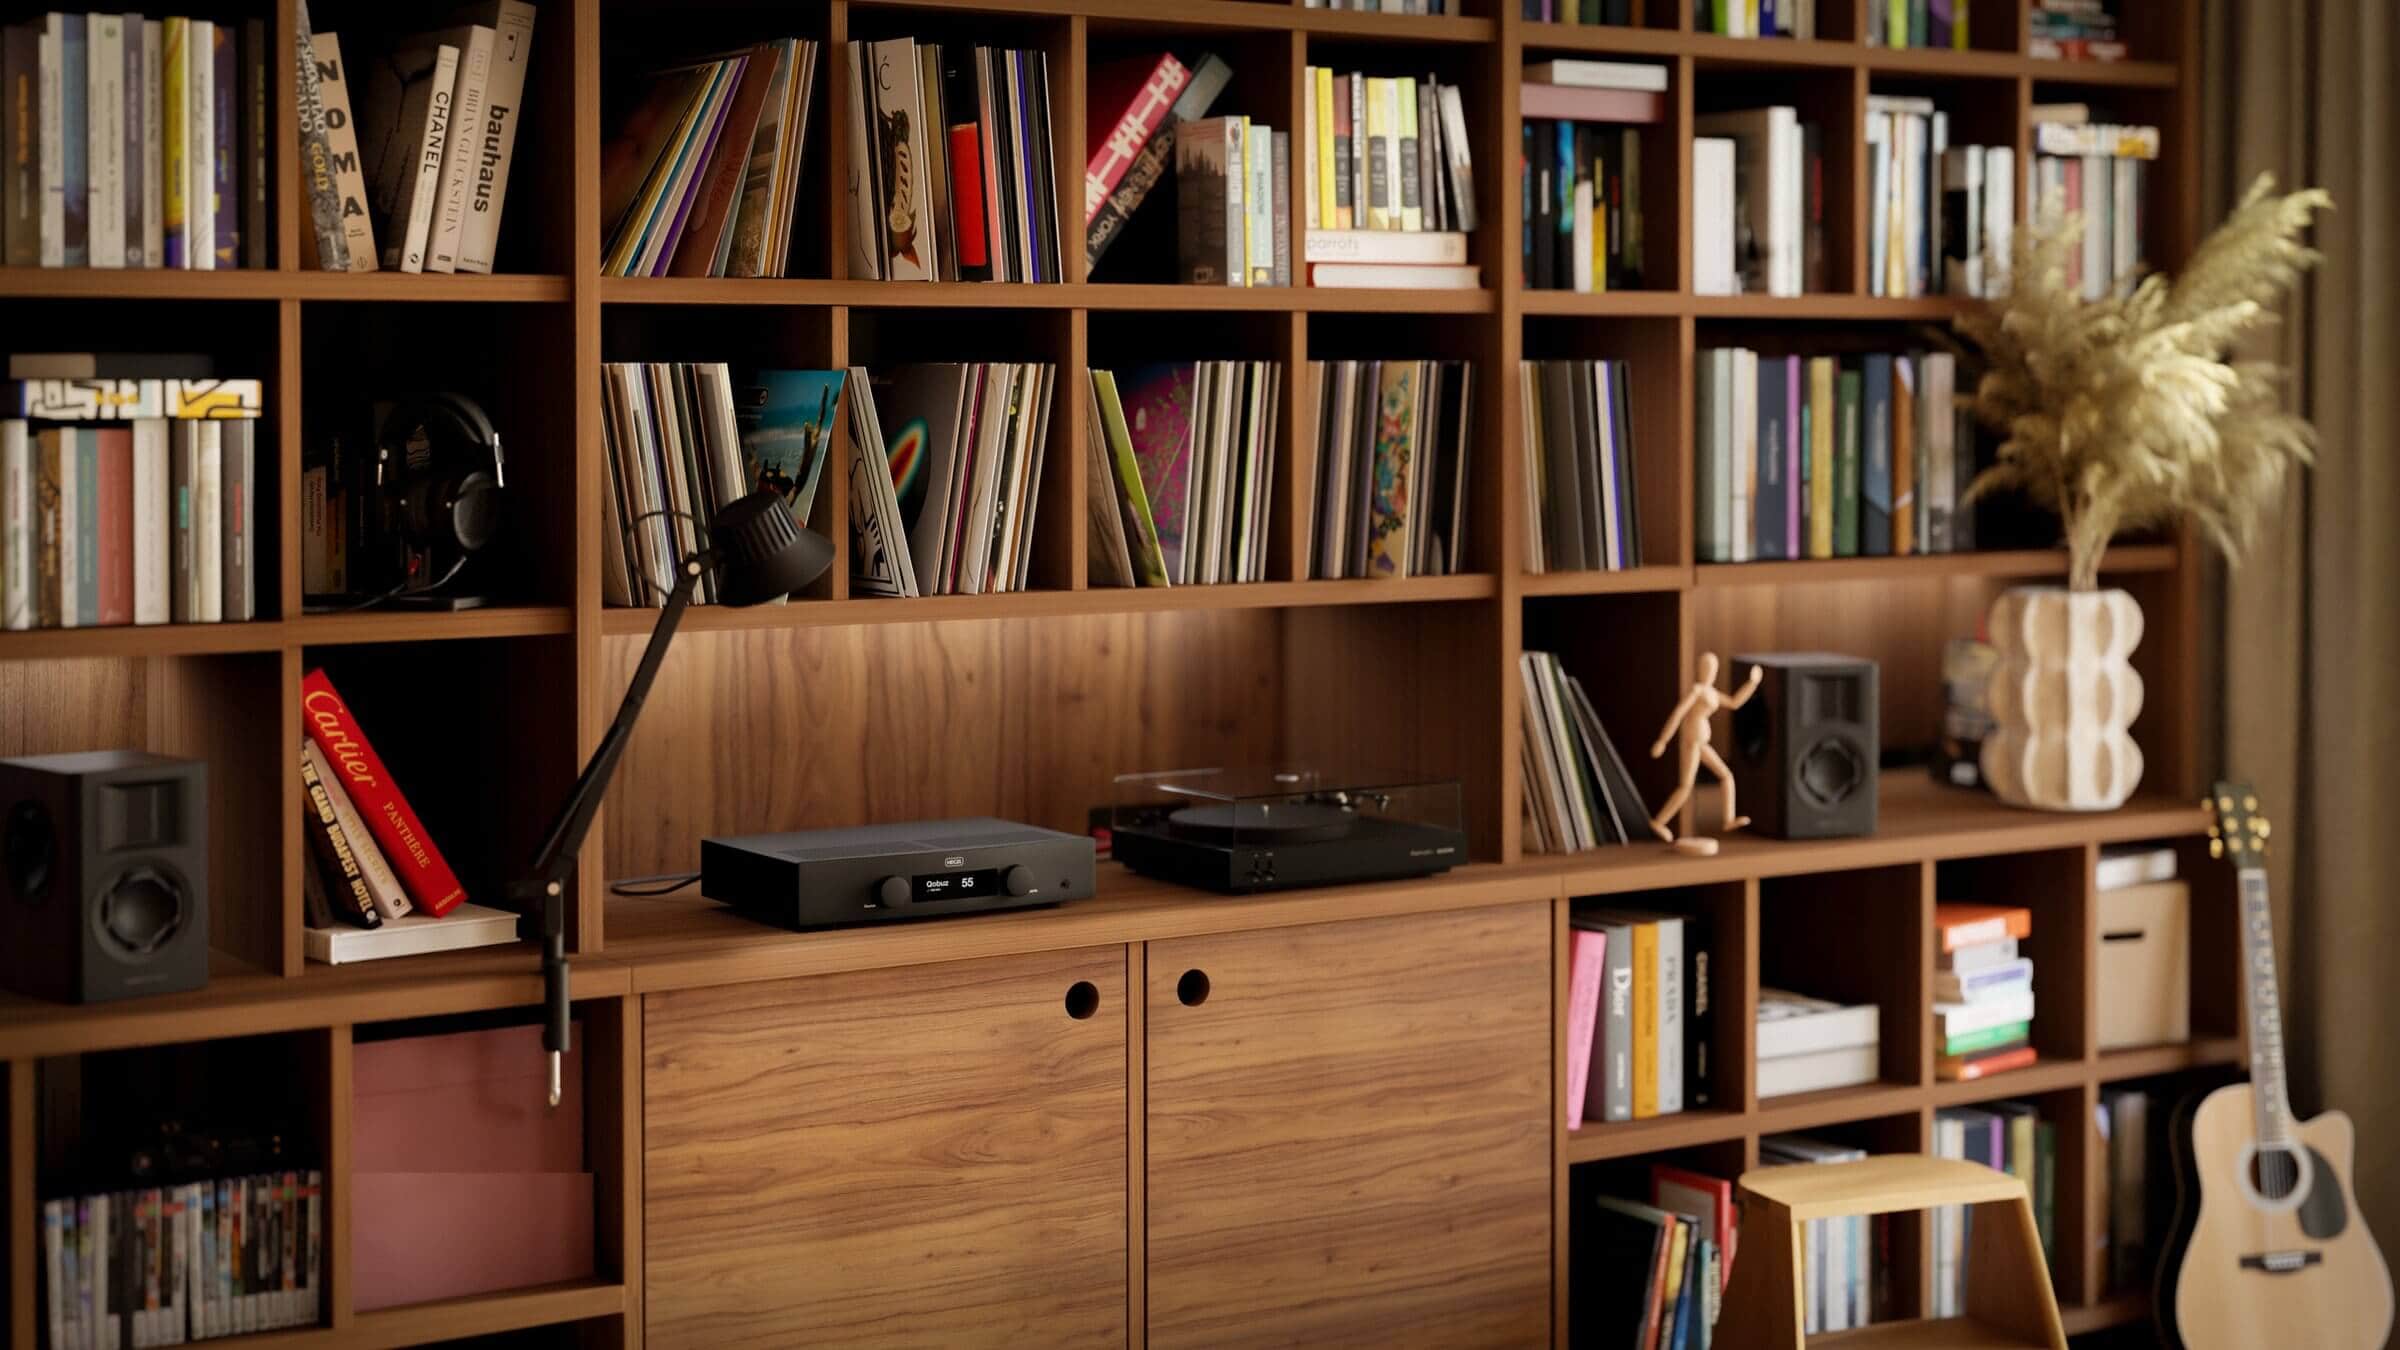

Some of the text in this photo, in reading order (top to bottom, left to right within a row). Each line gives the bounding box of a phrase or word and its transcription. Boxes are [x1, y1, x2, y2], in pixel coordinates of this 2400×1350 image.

[310, 143, 329, 193] GOLD
[317, 60, 364, 219] NOMA
[423, 91, 448, 174] CHANEL
[473, 104, 508, 214] bauhaus
[1087, 213, 1117, 249] YORK
[305, 690, 432, 869] Cartier PANTHÈRE
[301, 762, 316, 786] THE
[310, 784, 336, 824] GRAND
[326, 823, 361, 879] BUDAPEST
[350, 877, 373, 914] HOTEL
[926, 877, 974, 888] Qobuz 55
[1612, 967, 1632, 1017] Dior
